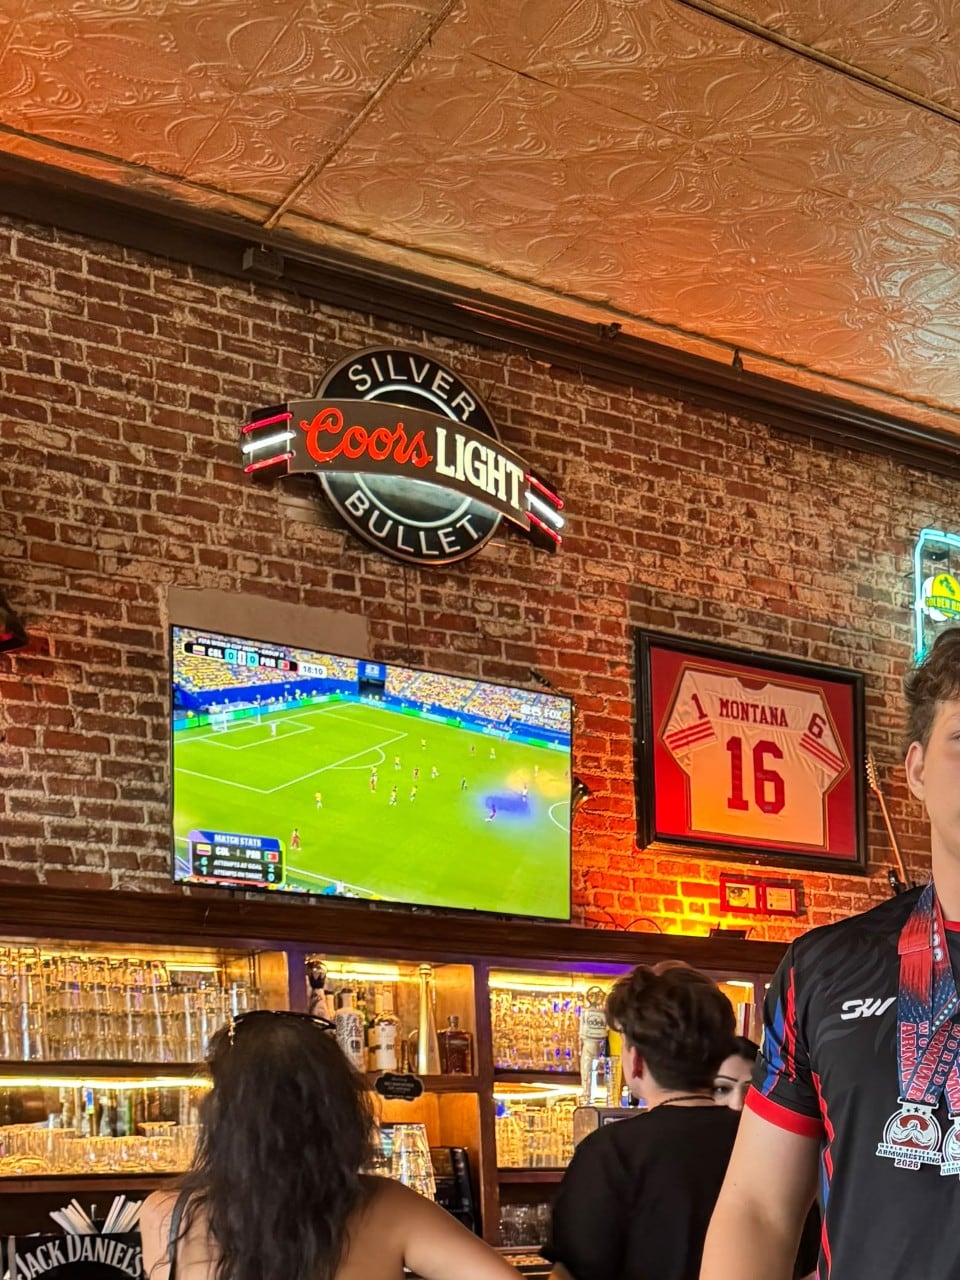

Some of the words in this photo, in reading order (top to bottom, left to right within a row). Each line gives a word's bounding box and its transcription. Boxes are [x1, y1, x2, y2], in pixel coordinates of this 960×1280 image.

[348, 354, 476, 422] SILVER
[300, 407, 433, 468] Coors
[434, 427, 525, 511] LIGHT
[345, 489, 480, 555] BULLET
[691, 693, 708, 720] 1
[719, 698, 789, 727] MONTANA
[808, 713, 827, 739] 6
[726, 736, 786, 814] 16
[877, 1148, 940, 1165] ARMWRESTLING
[895, 1159, 919, 1169] 2026
[66, 1234, 143, 1278] DANIEL'S
